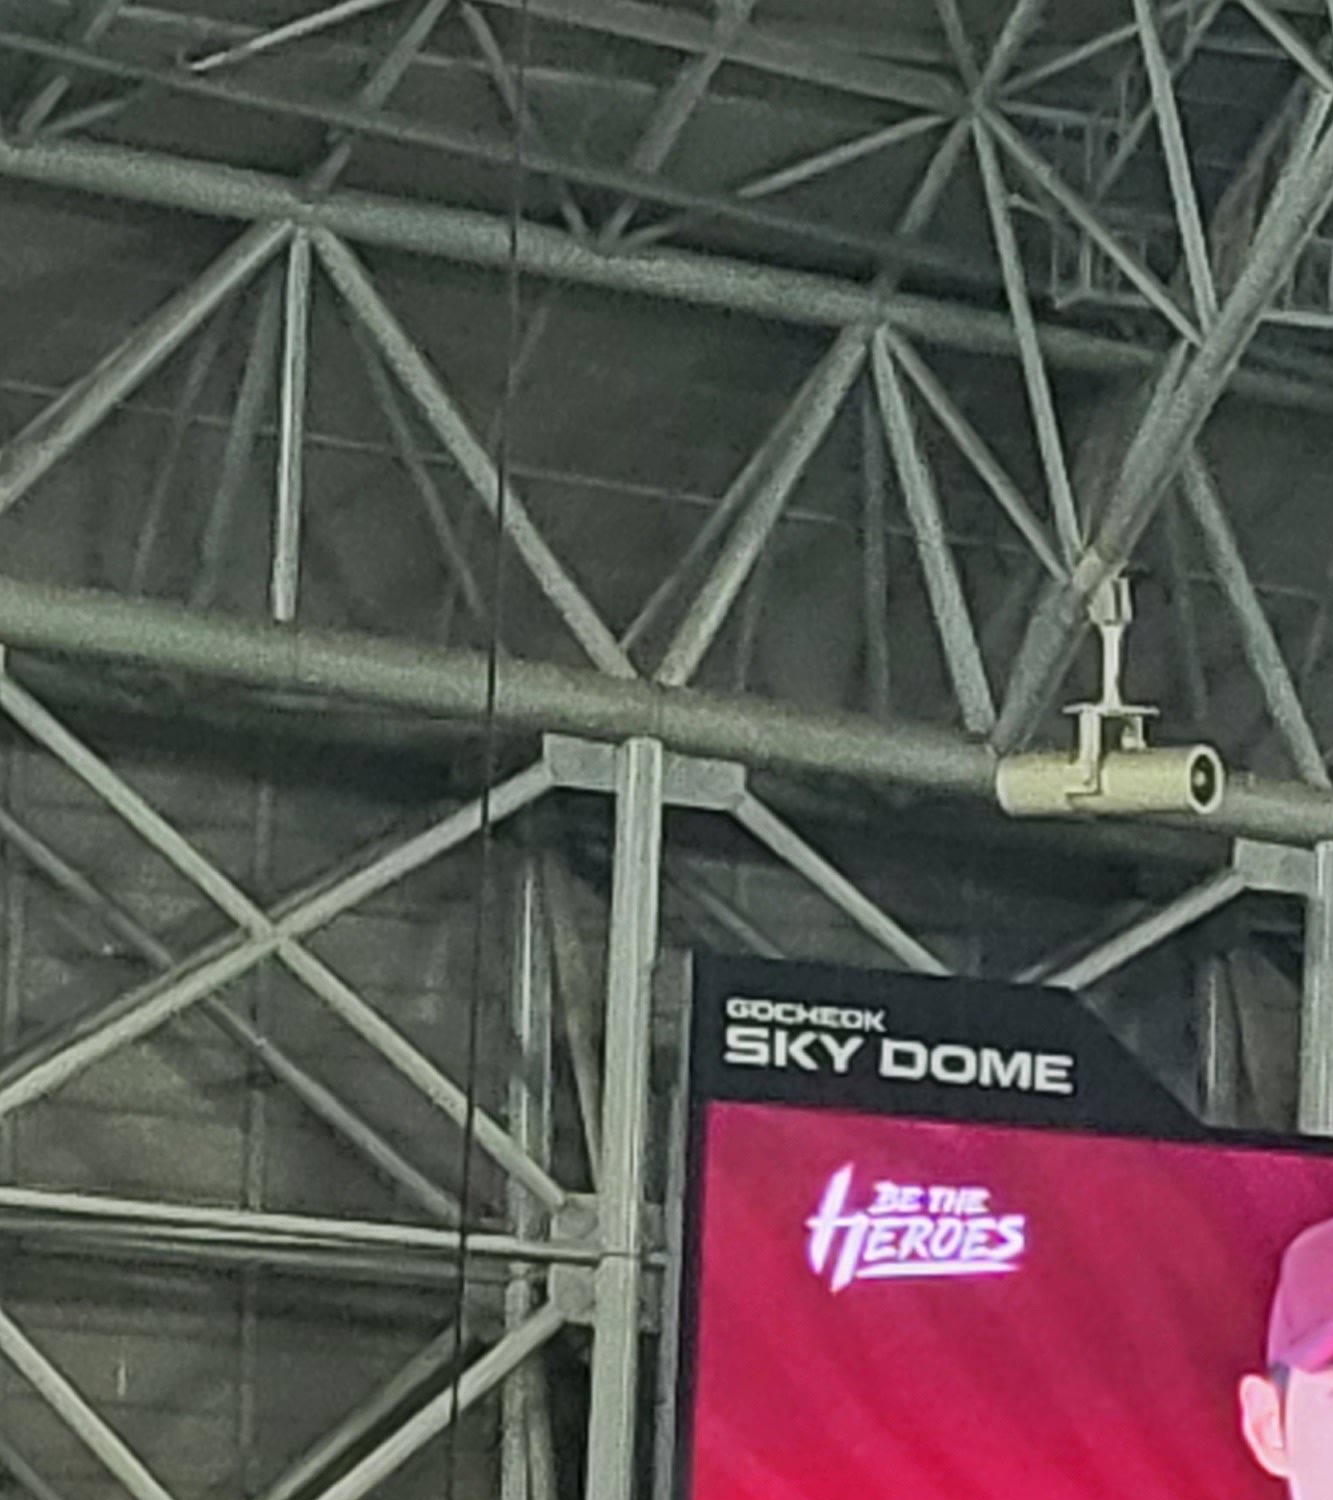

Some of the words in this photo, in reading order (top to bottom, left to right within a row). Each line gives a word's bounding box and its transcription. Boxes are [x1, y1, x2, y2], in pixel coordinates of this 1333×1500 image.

[726, 997, 887, 1032] GOCHEOK
[724, 1026, 864, 1073] SKY
[879, 1039, 1074, 1094] DOME
[867, 1180, 925, 1215] BE
[927, 1186, 990, 1215] THE
[805, 1162, 1025, 1294] HEROES
